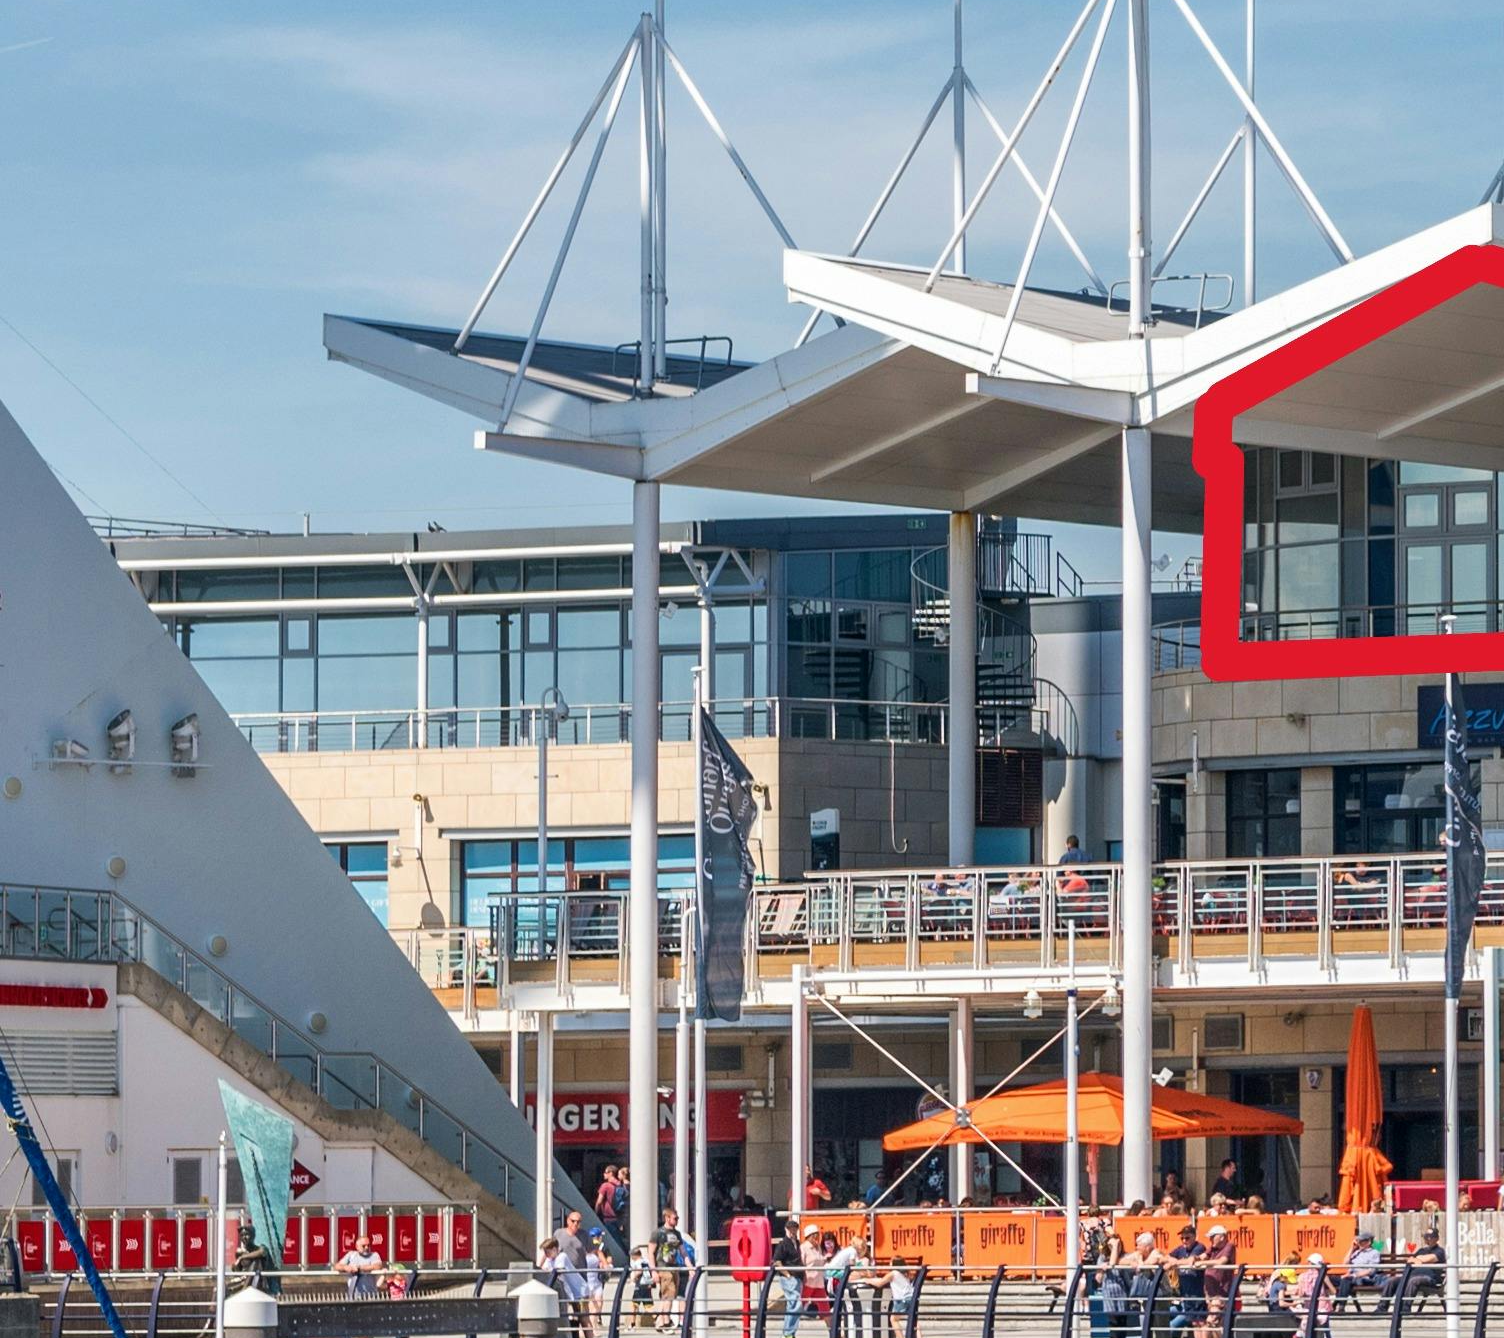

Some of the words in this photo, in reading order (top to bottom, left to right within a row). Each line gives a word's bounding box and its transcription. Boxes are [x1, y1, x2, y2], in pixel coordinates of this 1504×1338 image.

[891, 1224, 935, 1251] giraffe
[981, 1223, 1026, 1248] giraffe
[1297, 1224, 1336, 1252] giraffe
[1458, 1220, 1496, 1246] Bella
